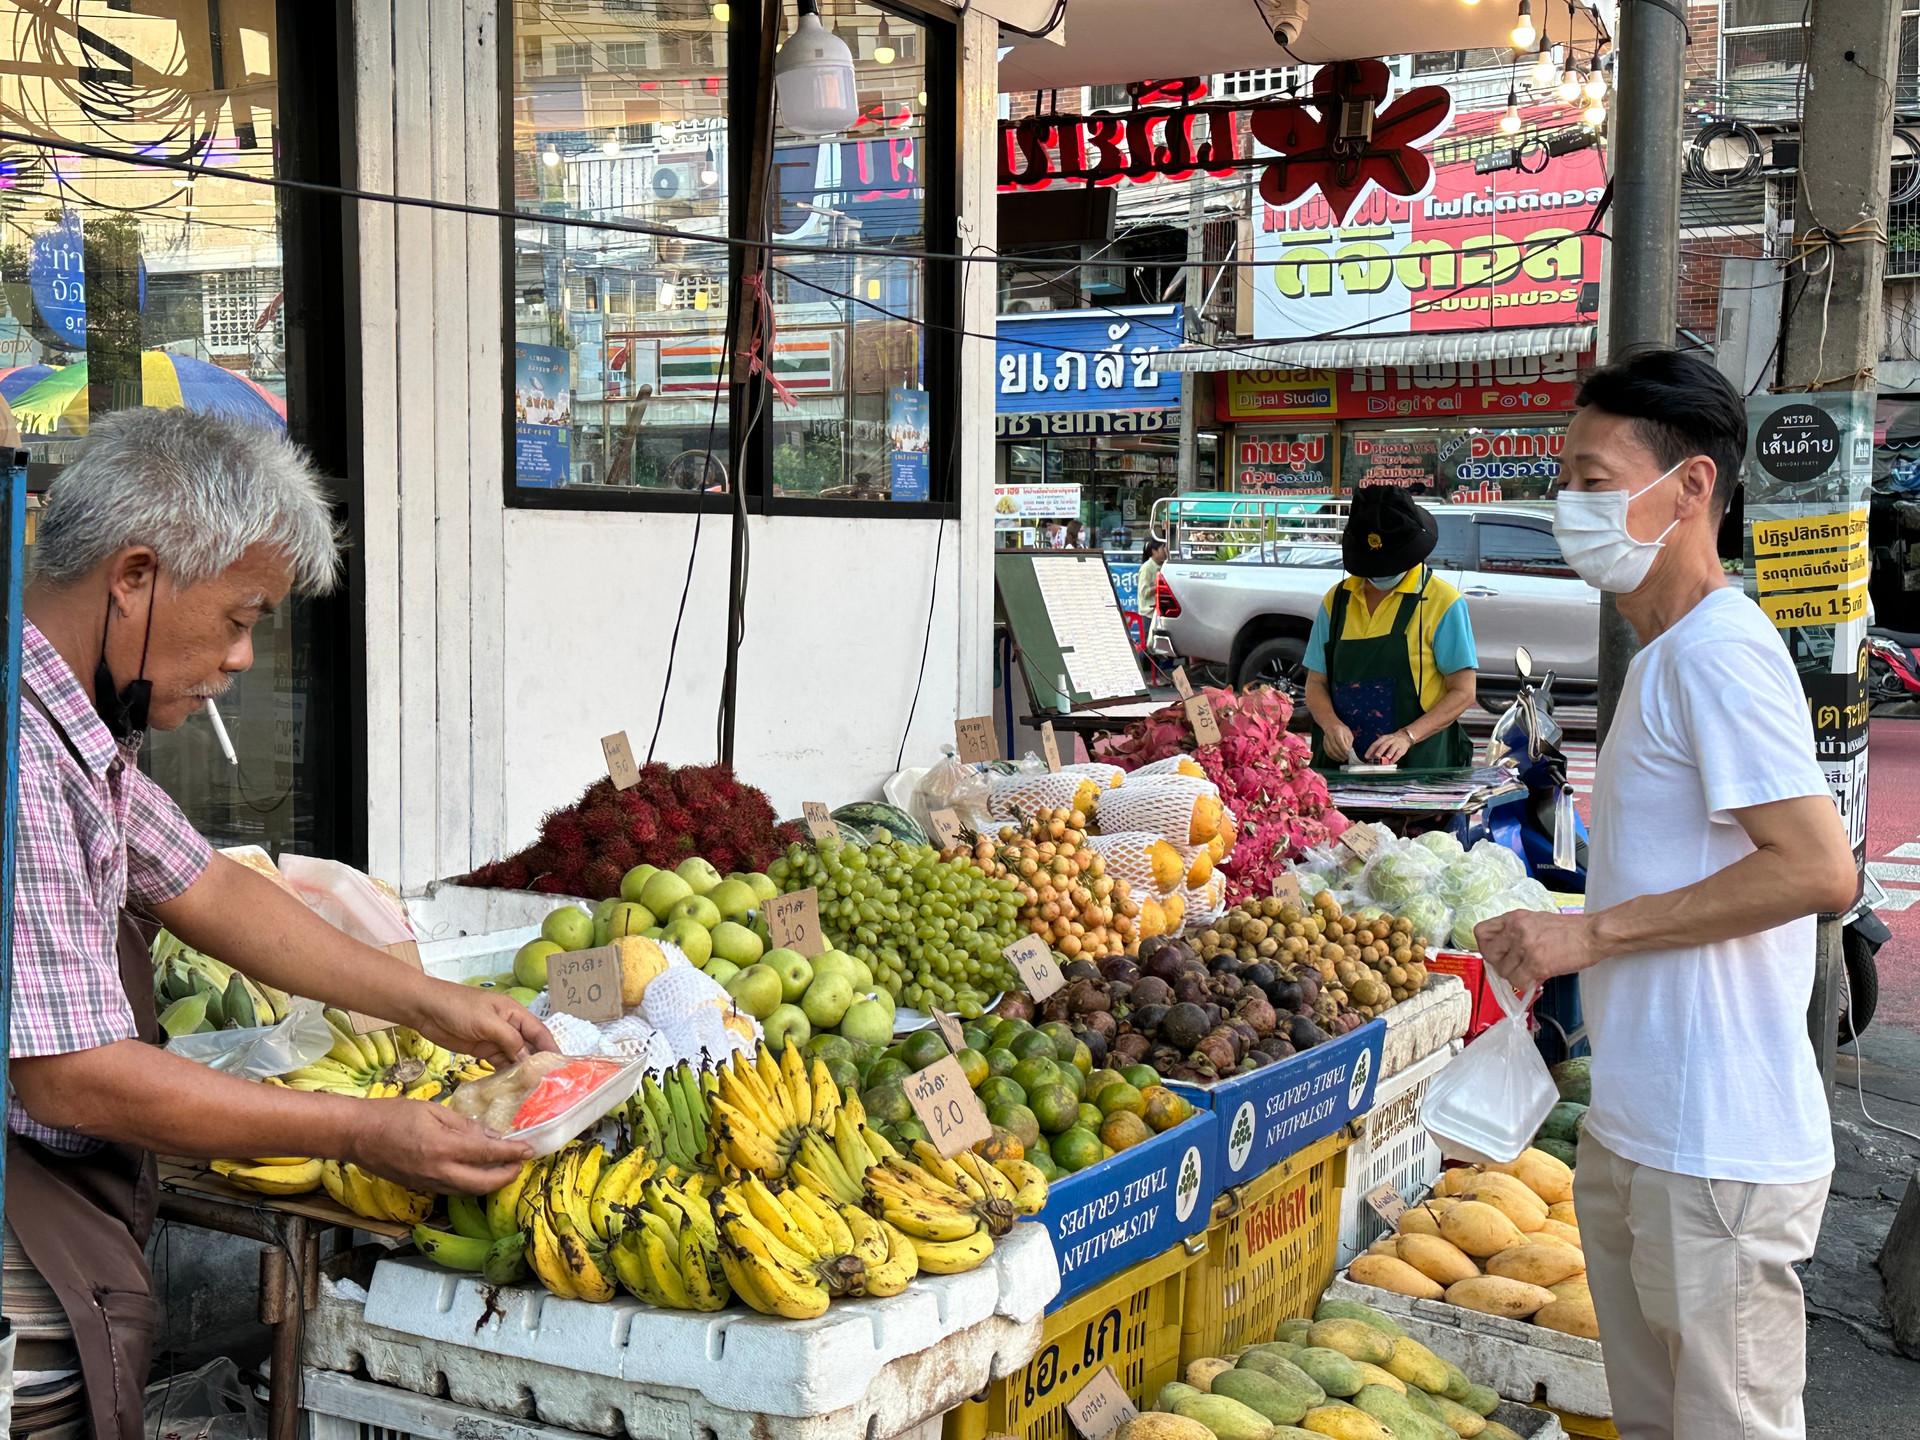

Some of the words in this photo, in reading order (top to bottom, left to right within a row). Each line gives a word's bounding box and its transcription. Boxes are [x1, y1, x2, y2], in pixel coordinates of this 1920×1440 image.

[1283, 392, 1328, 405] Studio
[1367, 392, 1462, 416] Digital
[1482, 391, 1550, 409] Foto
[1783, 414, 1813, 425] พรรค
[1240, 435, 1325, 472] ถ่ายรูป
[1762, 431, 1834, 455] เส้นด้าย
[1775, 602, 1822, 620] ภายใน
[1828, 597, 1852, 616] 15
[567, 983, 602, 1007] 20
[1312, 1063, 1347, 1096] TABLE
[1265, 1081, 1311, 1119] GRAPES
[933, 1099, 964, 1138] 20
[1266, 1095, 1337, 1149] AUSTRALIAN
[1123, 1166, 1169, 1209] TABLE
[1059, 1192, 1120, 1240] GRAPES
[1061, 1204, 1159, 1276] AUSTRALIAN
